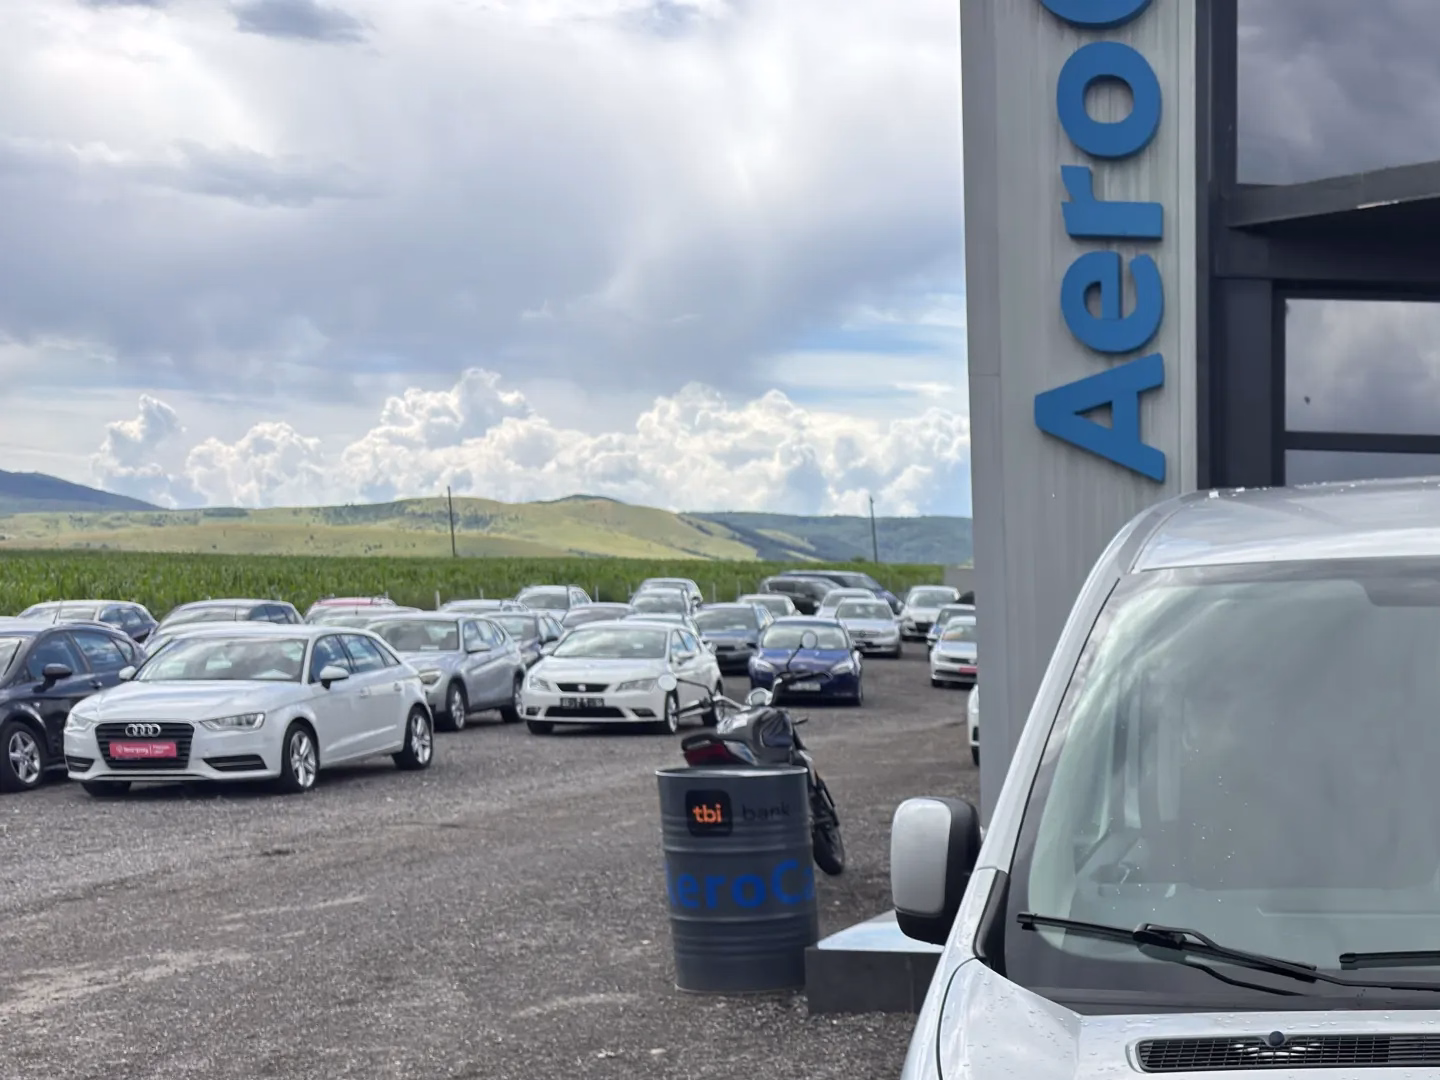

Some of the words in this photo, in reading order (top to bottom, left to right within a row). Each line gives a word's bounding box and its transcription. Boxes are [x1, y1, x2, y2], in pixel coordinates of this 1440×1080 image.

[1035, 0, 1165, 484] Aero
[692, 803, 723, 823] tbi
[742, 802, 790, 822] bank
